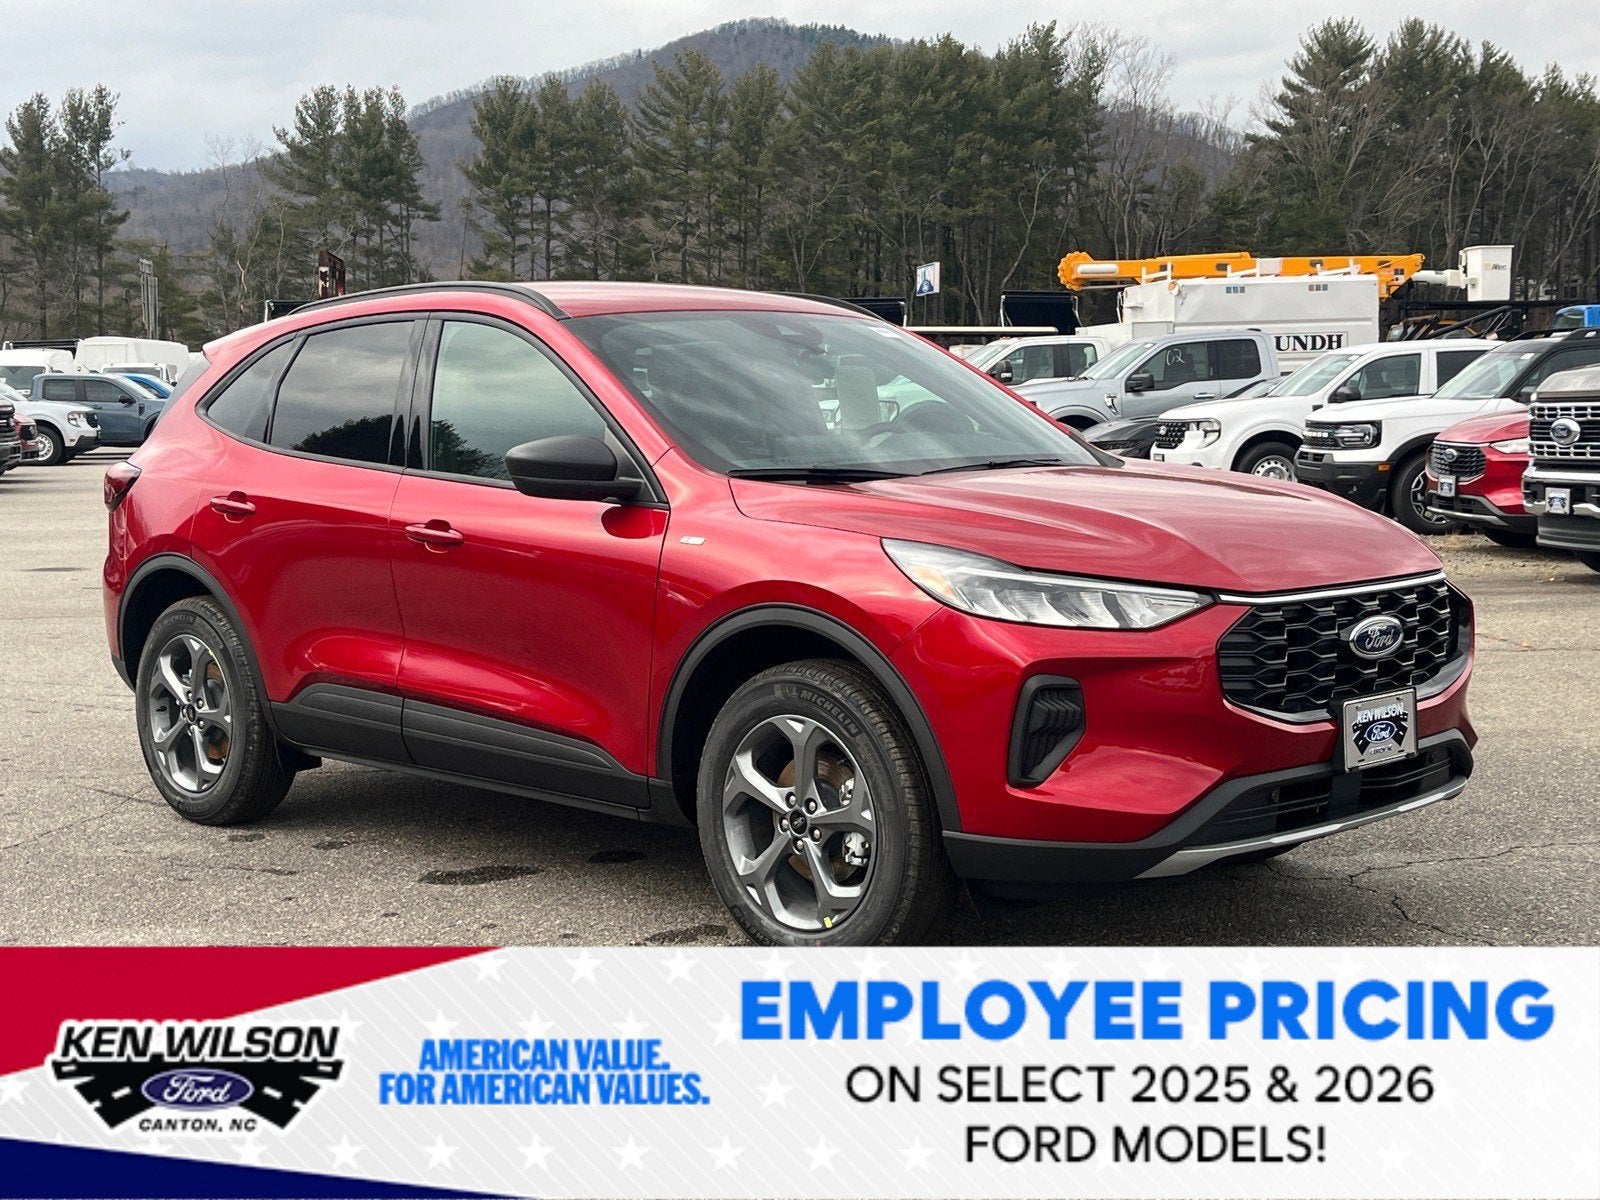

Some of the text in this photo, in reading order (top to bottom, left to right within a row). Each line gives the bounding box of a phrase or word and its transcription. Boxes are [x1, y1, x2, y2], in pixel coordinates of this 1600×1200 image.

[1365, 625, 1395, 650] Ford
[800, 689, 861, 738] MICHELIN
[1356, 702, 1404, 724] KEN WILSON
[1371, 724, 1391, 741] Ford
